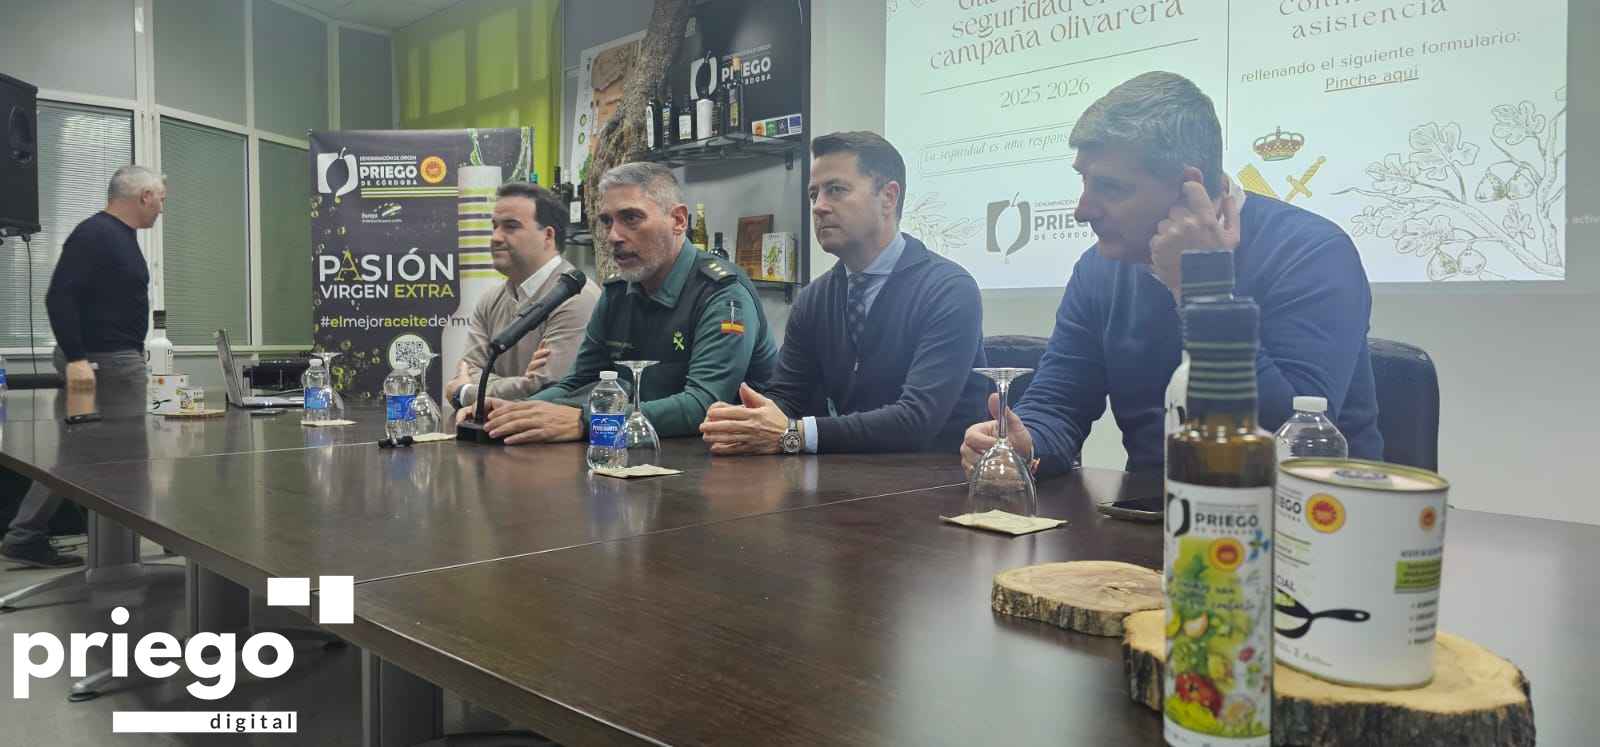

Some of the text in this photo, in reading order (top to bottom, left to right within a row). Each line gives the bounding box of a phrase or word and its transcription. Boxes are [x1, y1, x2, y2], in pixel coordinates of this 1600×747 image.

[1292, 0, 1448, 39] asistencia
[930, 0, 1184, 70] campaña olivarera
[1241, 31, 1521, 83] rellenando el siguiente formulario:
[1000, 76, 1090, 108] 2025 2026
[1325, 72, 1377, 90] Pinche
[360, 165, 417, 179] PRIEGO
[1034, 213, 1087, 232] PRIE
[319, 247, 455, 282] PASIÓN
[320, 283, 454, 298] VIRGEN EXTRA
[1195, 513, 1259, 528] PRIEGO
